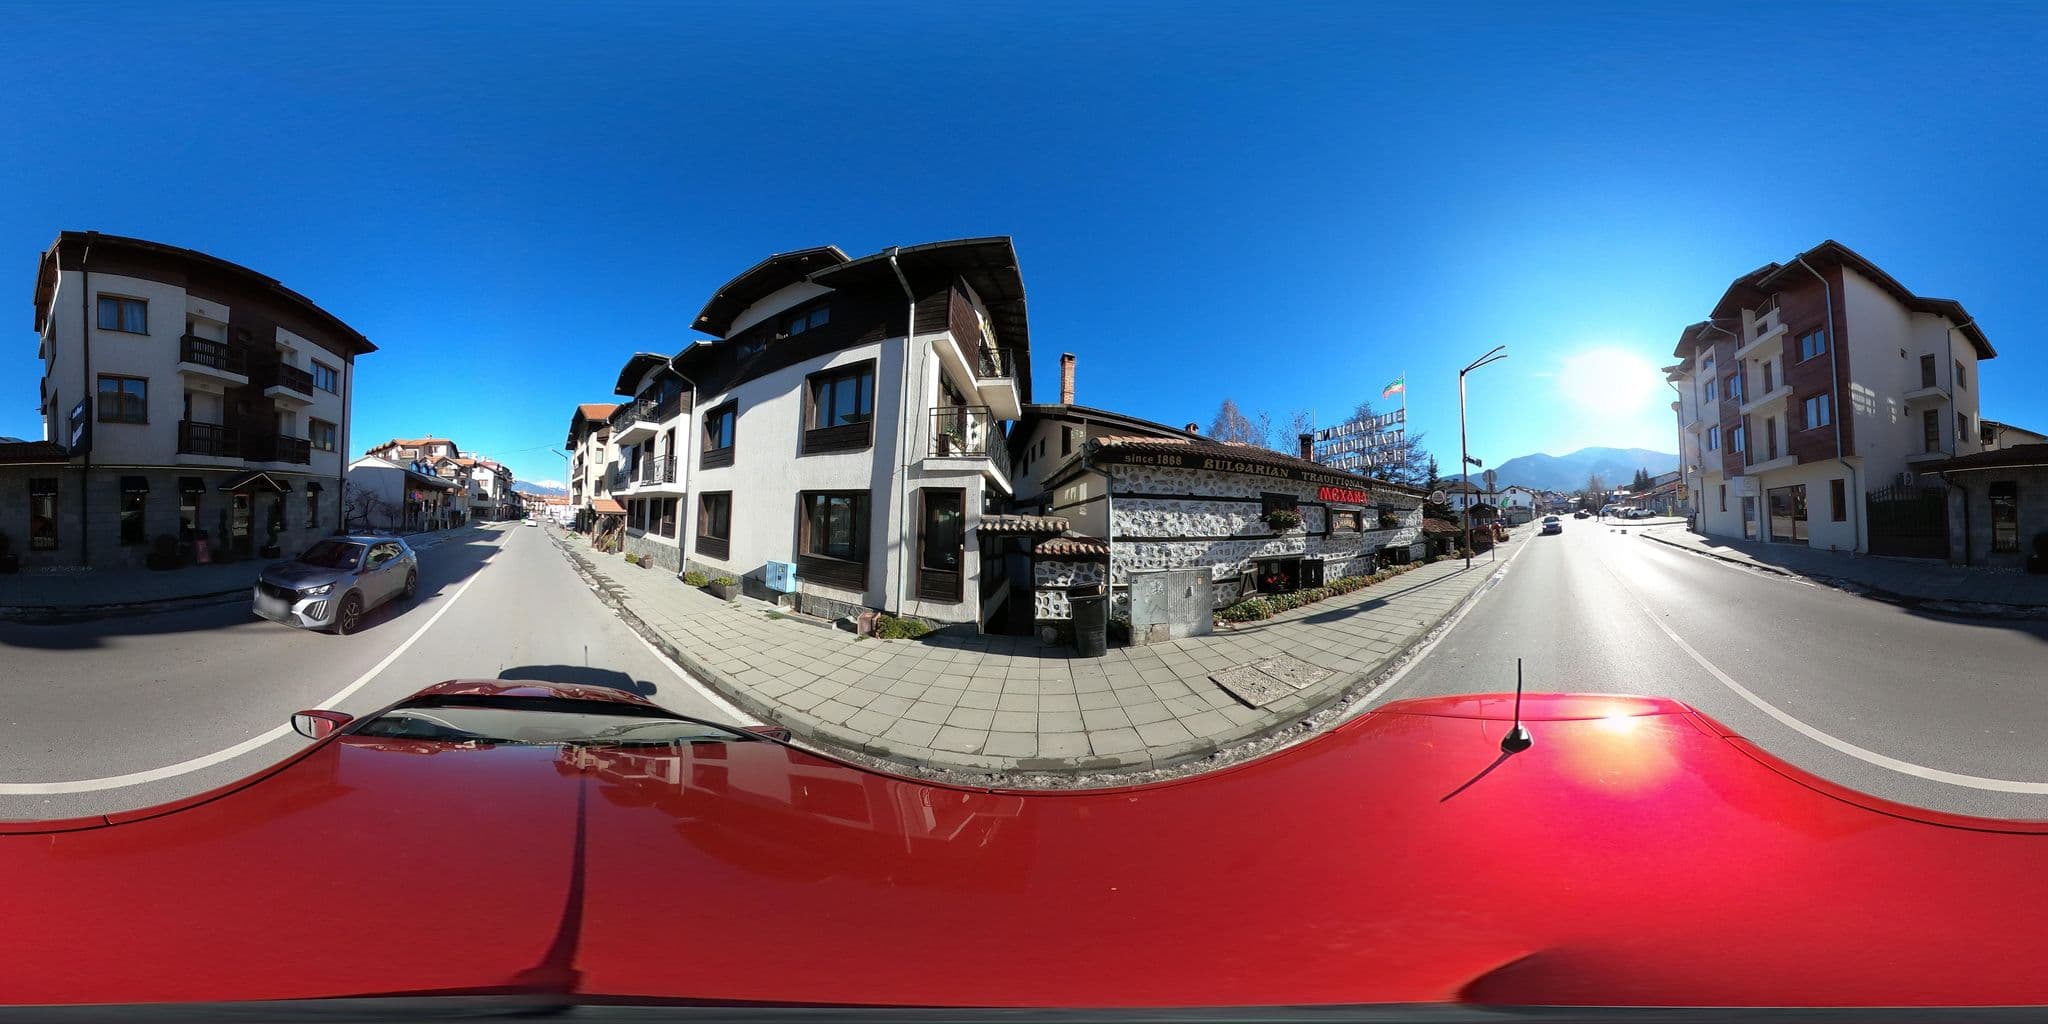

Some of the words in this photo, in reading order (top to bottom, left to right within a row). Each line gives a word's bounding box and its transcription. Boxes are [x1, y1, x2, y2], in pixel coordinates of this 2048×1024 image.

[1125, 454, 1153, 464] since
[1157, 454, 1182, 466] 1888
[1204, 458, 1289, 478] BULGARIAN
[1301, 471, 1364, 489] TRADITIONAL
